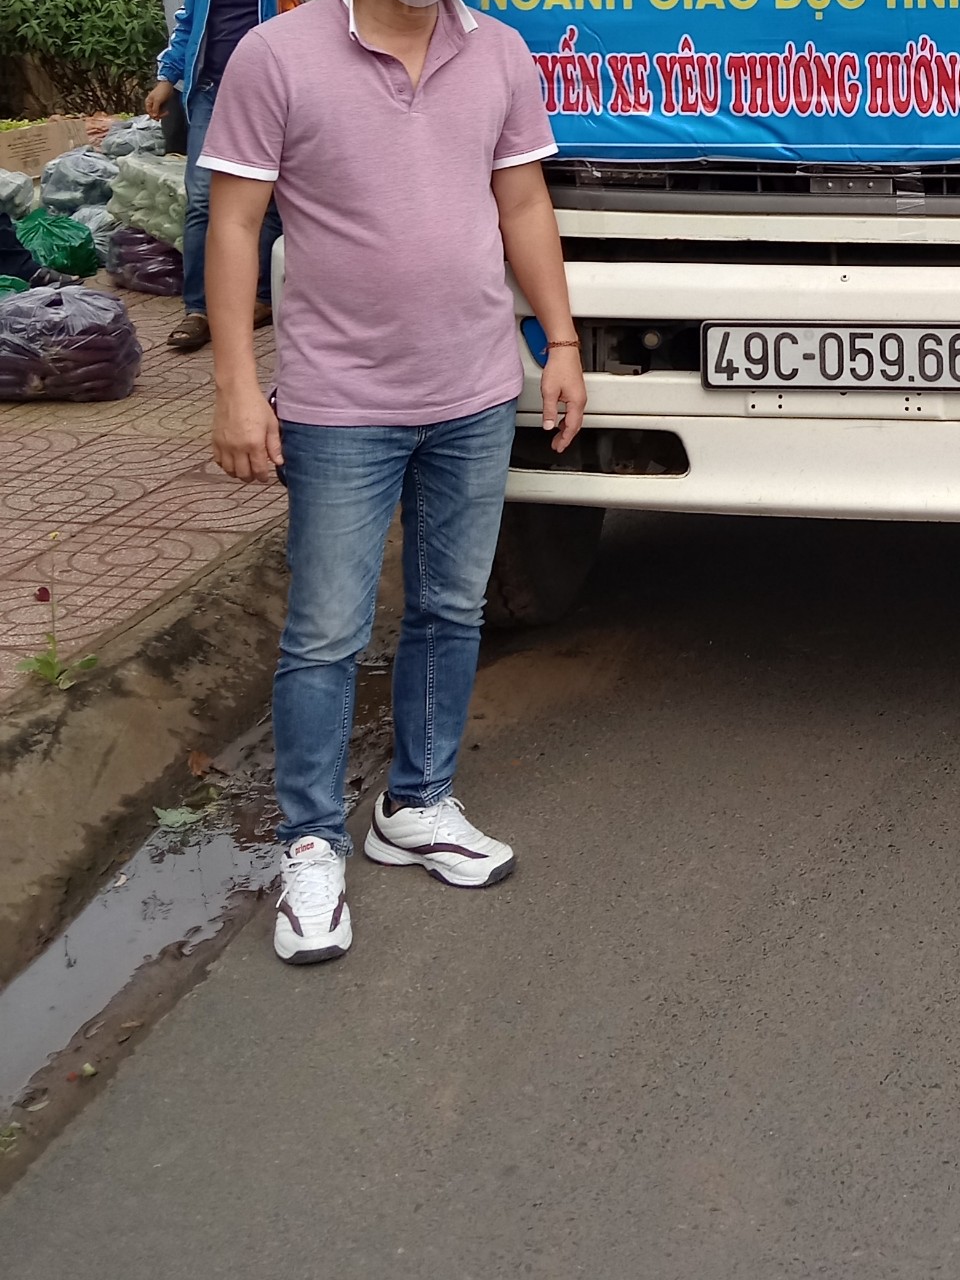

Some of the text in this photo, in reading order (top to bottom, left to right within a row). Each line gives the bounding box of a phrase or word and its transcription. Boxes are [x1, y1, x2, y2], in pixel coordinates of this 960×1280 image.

[607, 53, 652, 115] XE
[656, 34, 721, 117] YÊU
[727, 41, 861, 117] THƯƠNG
